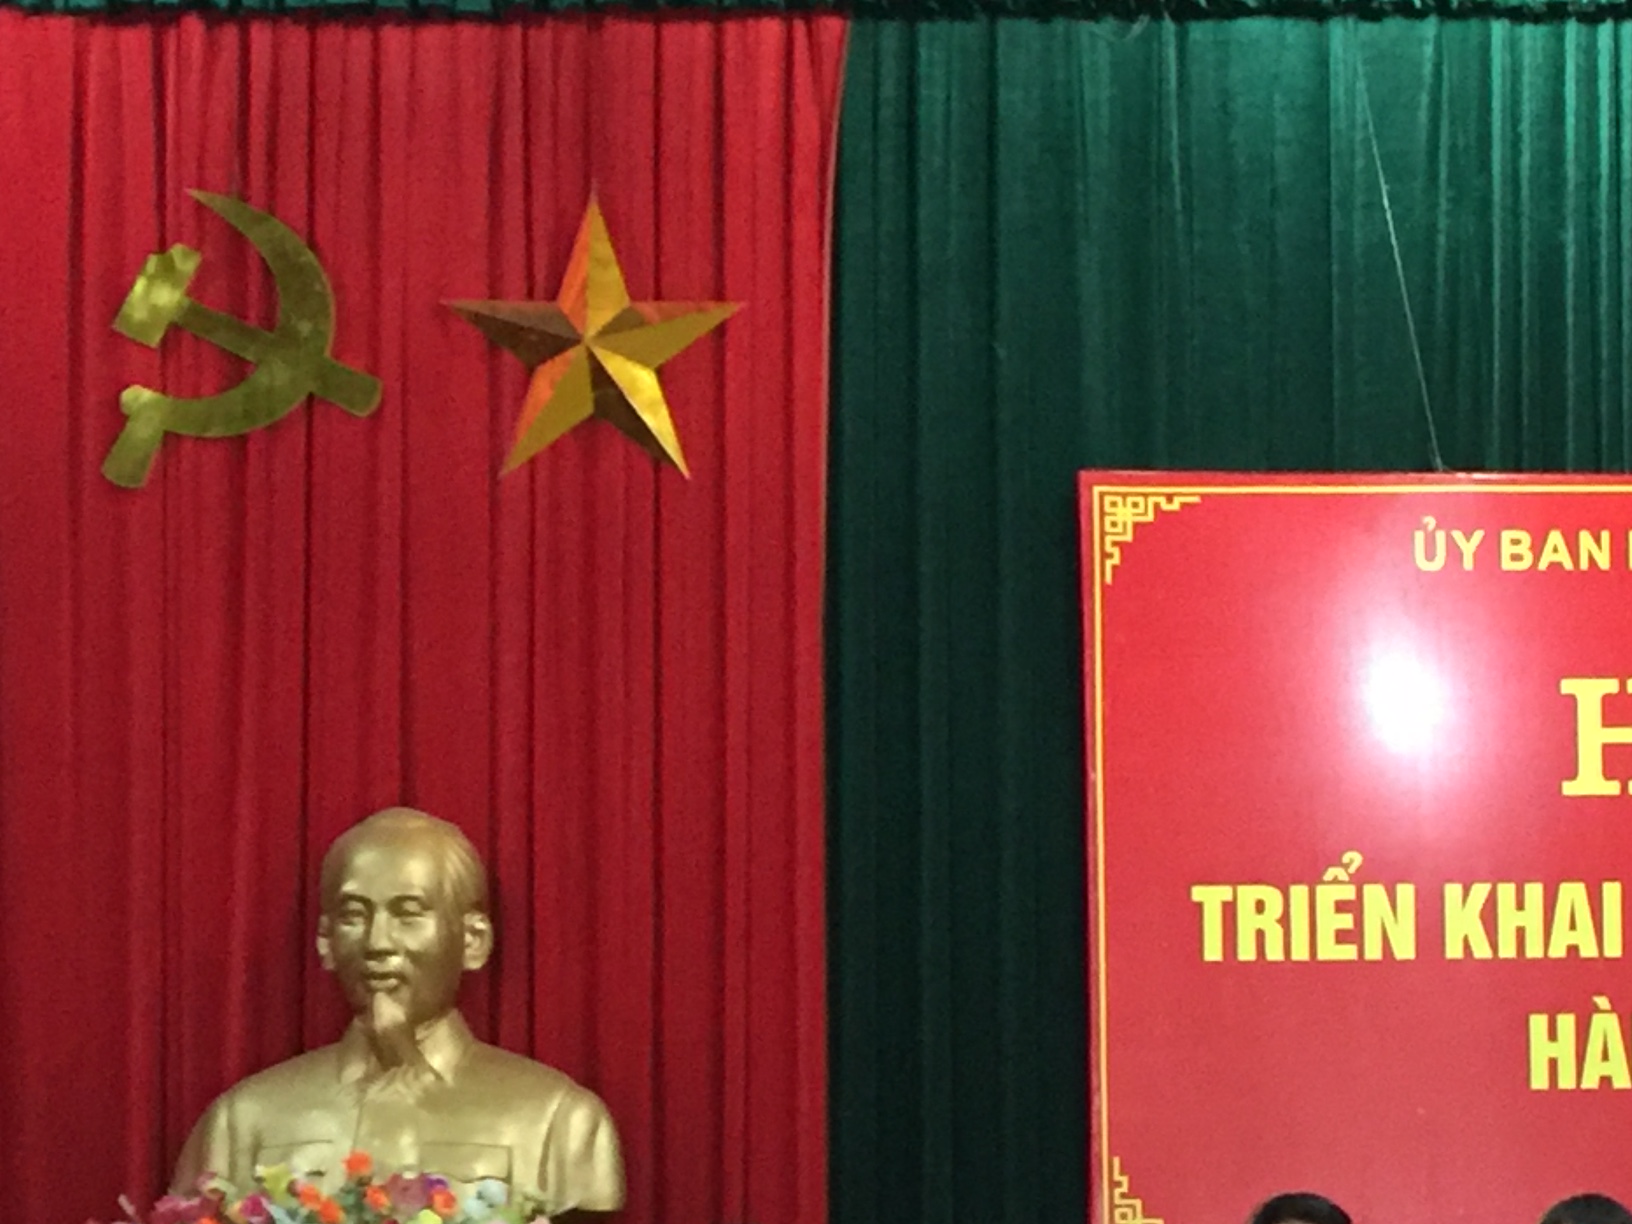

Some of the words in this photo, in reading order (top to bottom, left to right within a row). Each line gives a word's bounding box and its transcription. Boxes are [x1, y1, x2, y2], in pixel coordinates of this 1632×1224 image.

[1415, 516, 1484, 570] ỦY
[1500, 528, 1611, 571] BAN
[1190, 850, 1417, 962] TRIỂN
[1443, 880, 1623, 960] KHAI
